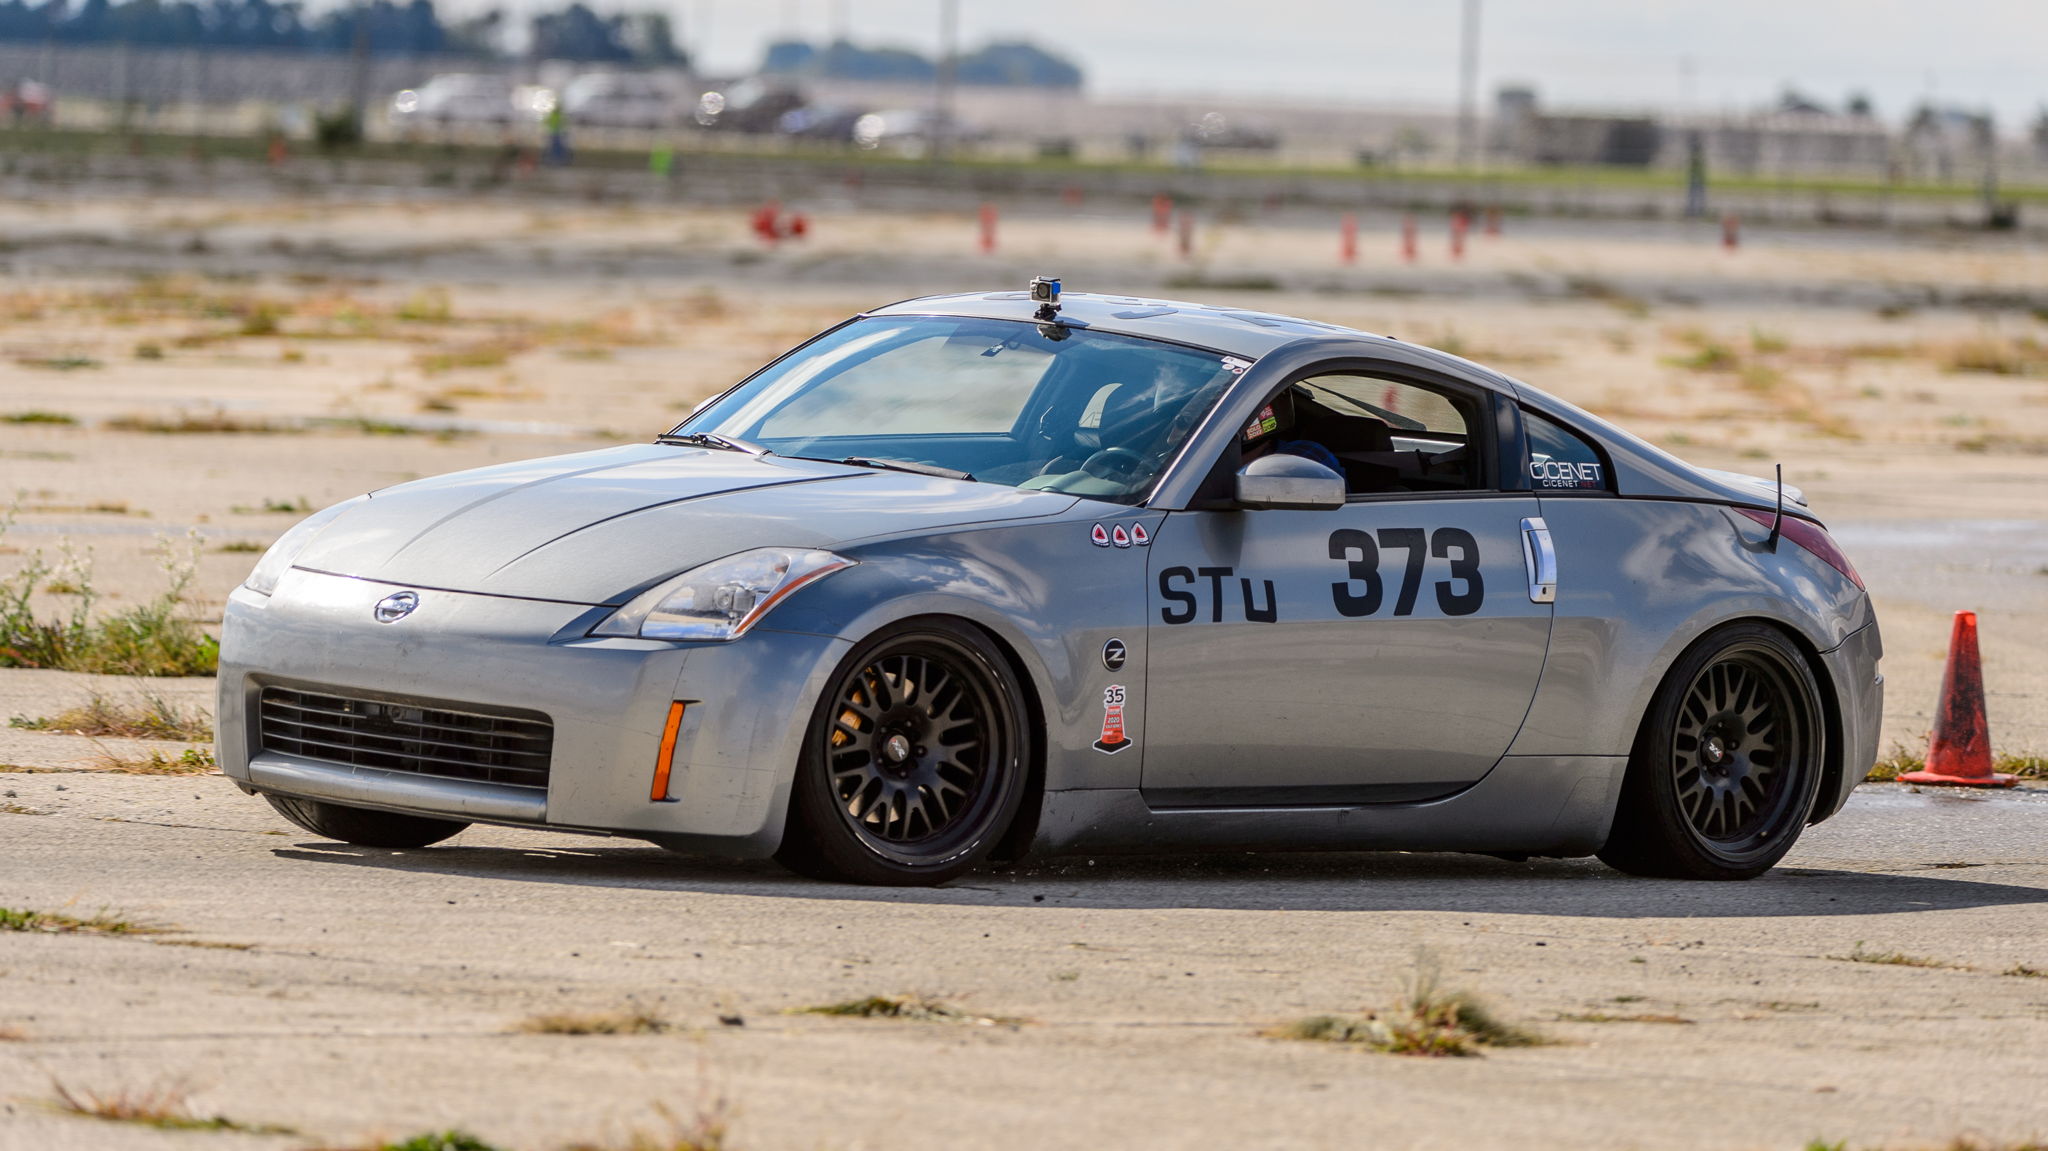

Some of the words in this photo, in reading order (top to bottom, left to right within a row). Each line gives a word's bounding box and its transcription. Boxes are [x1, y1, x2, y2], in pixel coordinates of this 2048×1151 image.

[1529, 462, 1600, 480] CICENET
[1542, 480, 1578, 488] CICENET
[1328, 527, 1485, 617] 373
[1107, 648, 1125, 661] Z
[1106, 689, 1124, 703] 35
